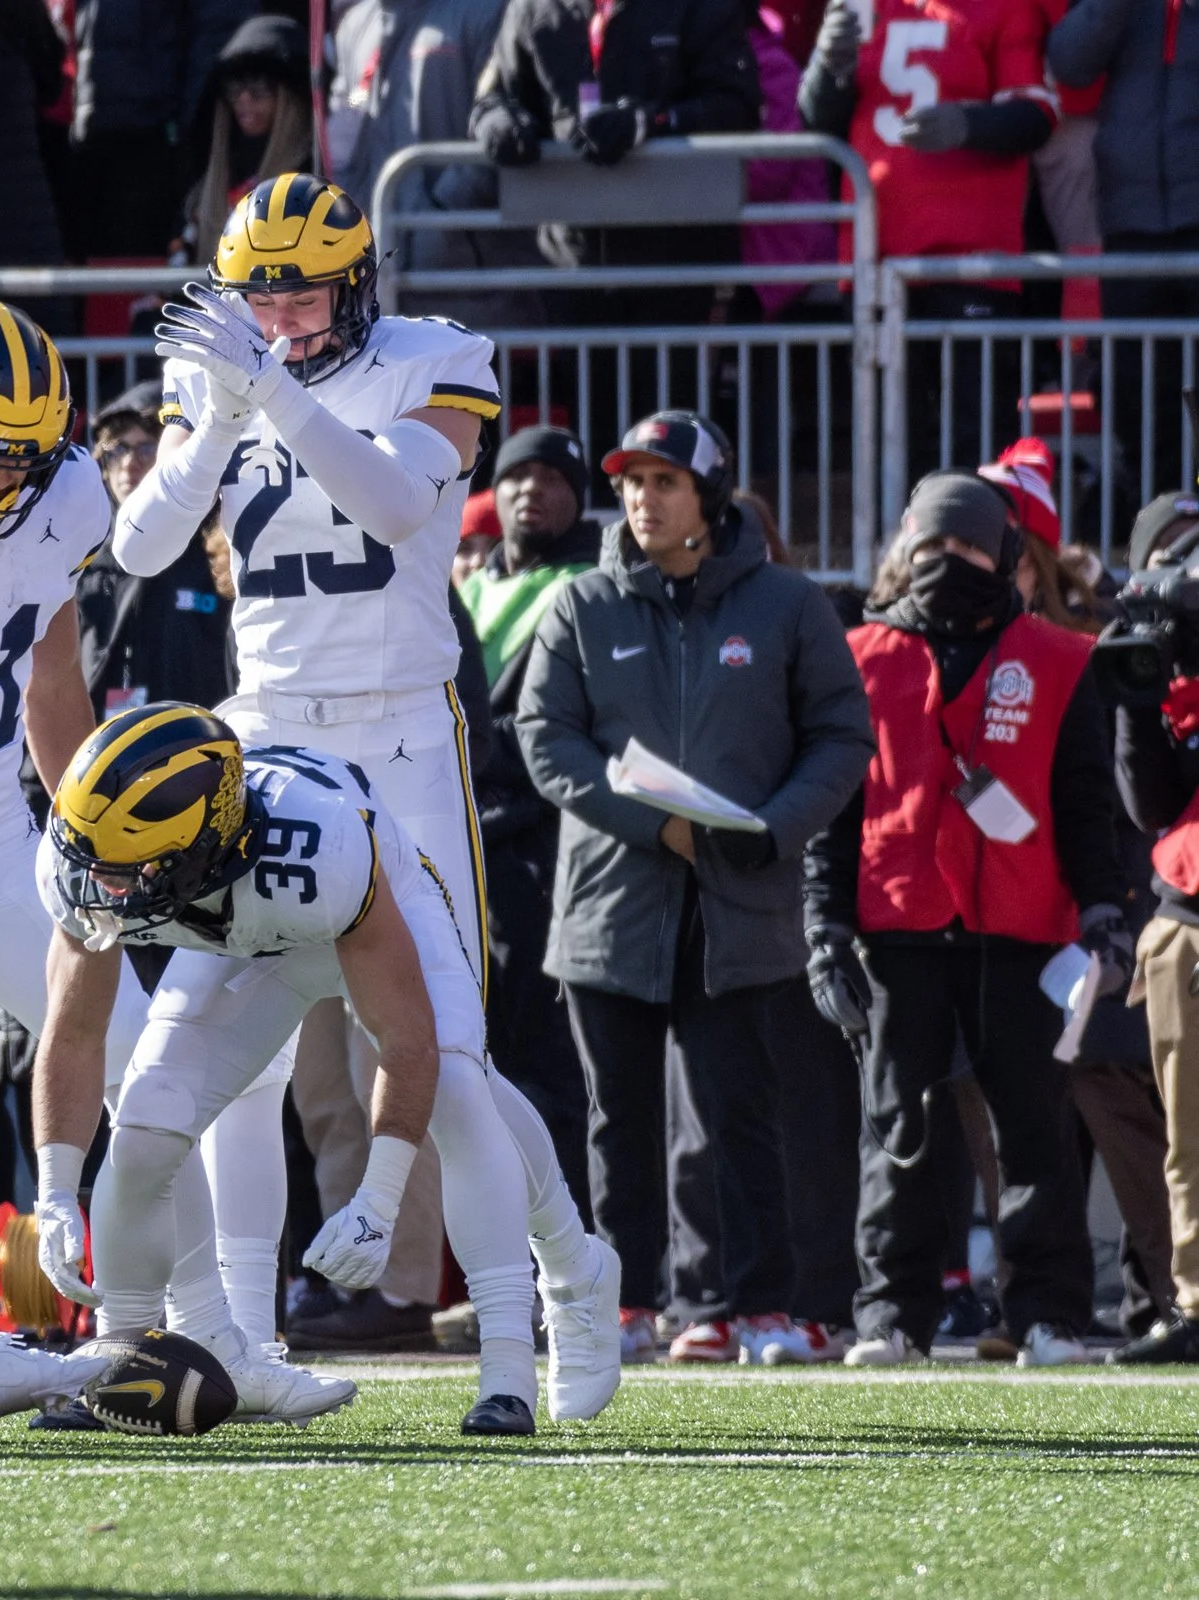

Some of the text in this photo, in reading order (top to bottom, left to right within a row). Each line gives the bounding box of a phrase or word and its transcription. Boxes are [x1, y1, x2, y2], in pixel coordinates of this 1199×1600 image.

[873, 19, 948, 147] 5
[984, 706, 1028, 725] TEAM
[984, 721, 1018, 744] 203
[254, 815, 322, 905] 39
